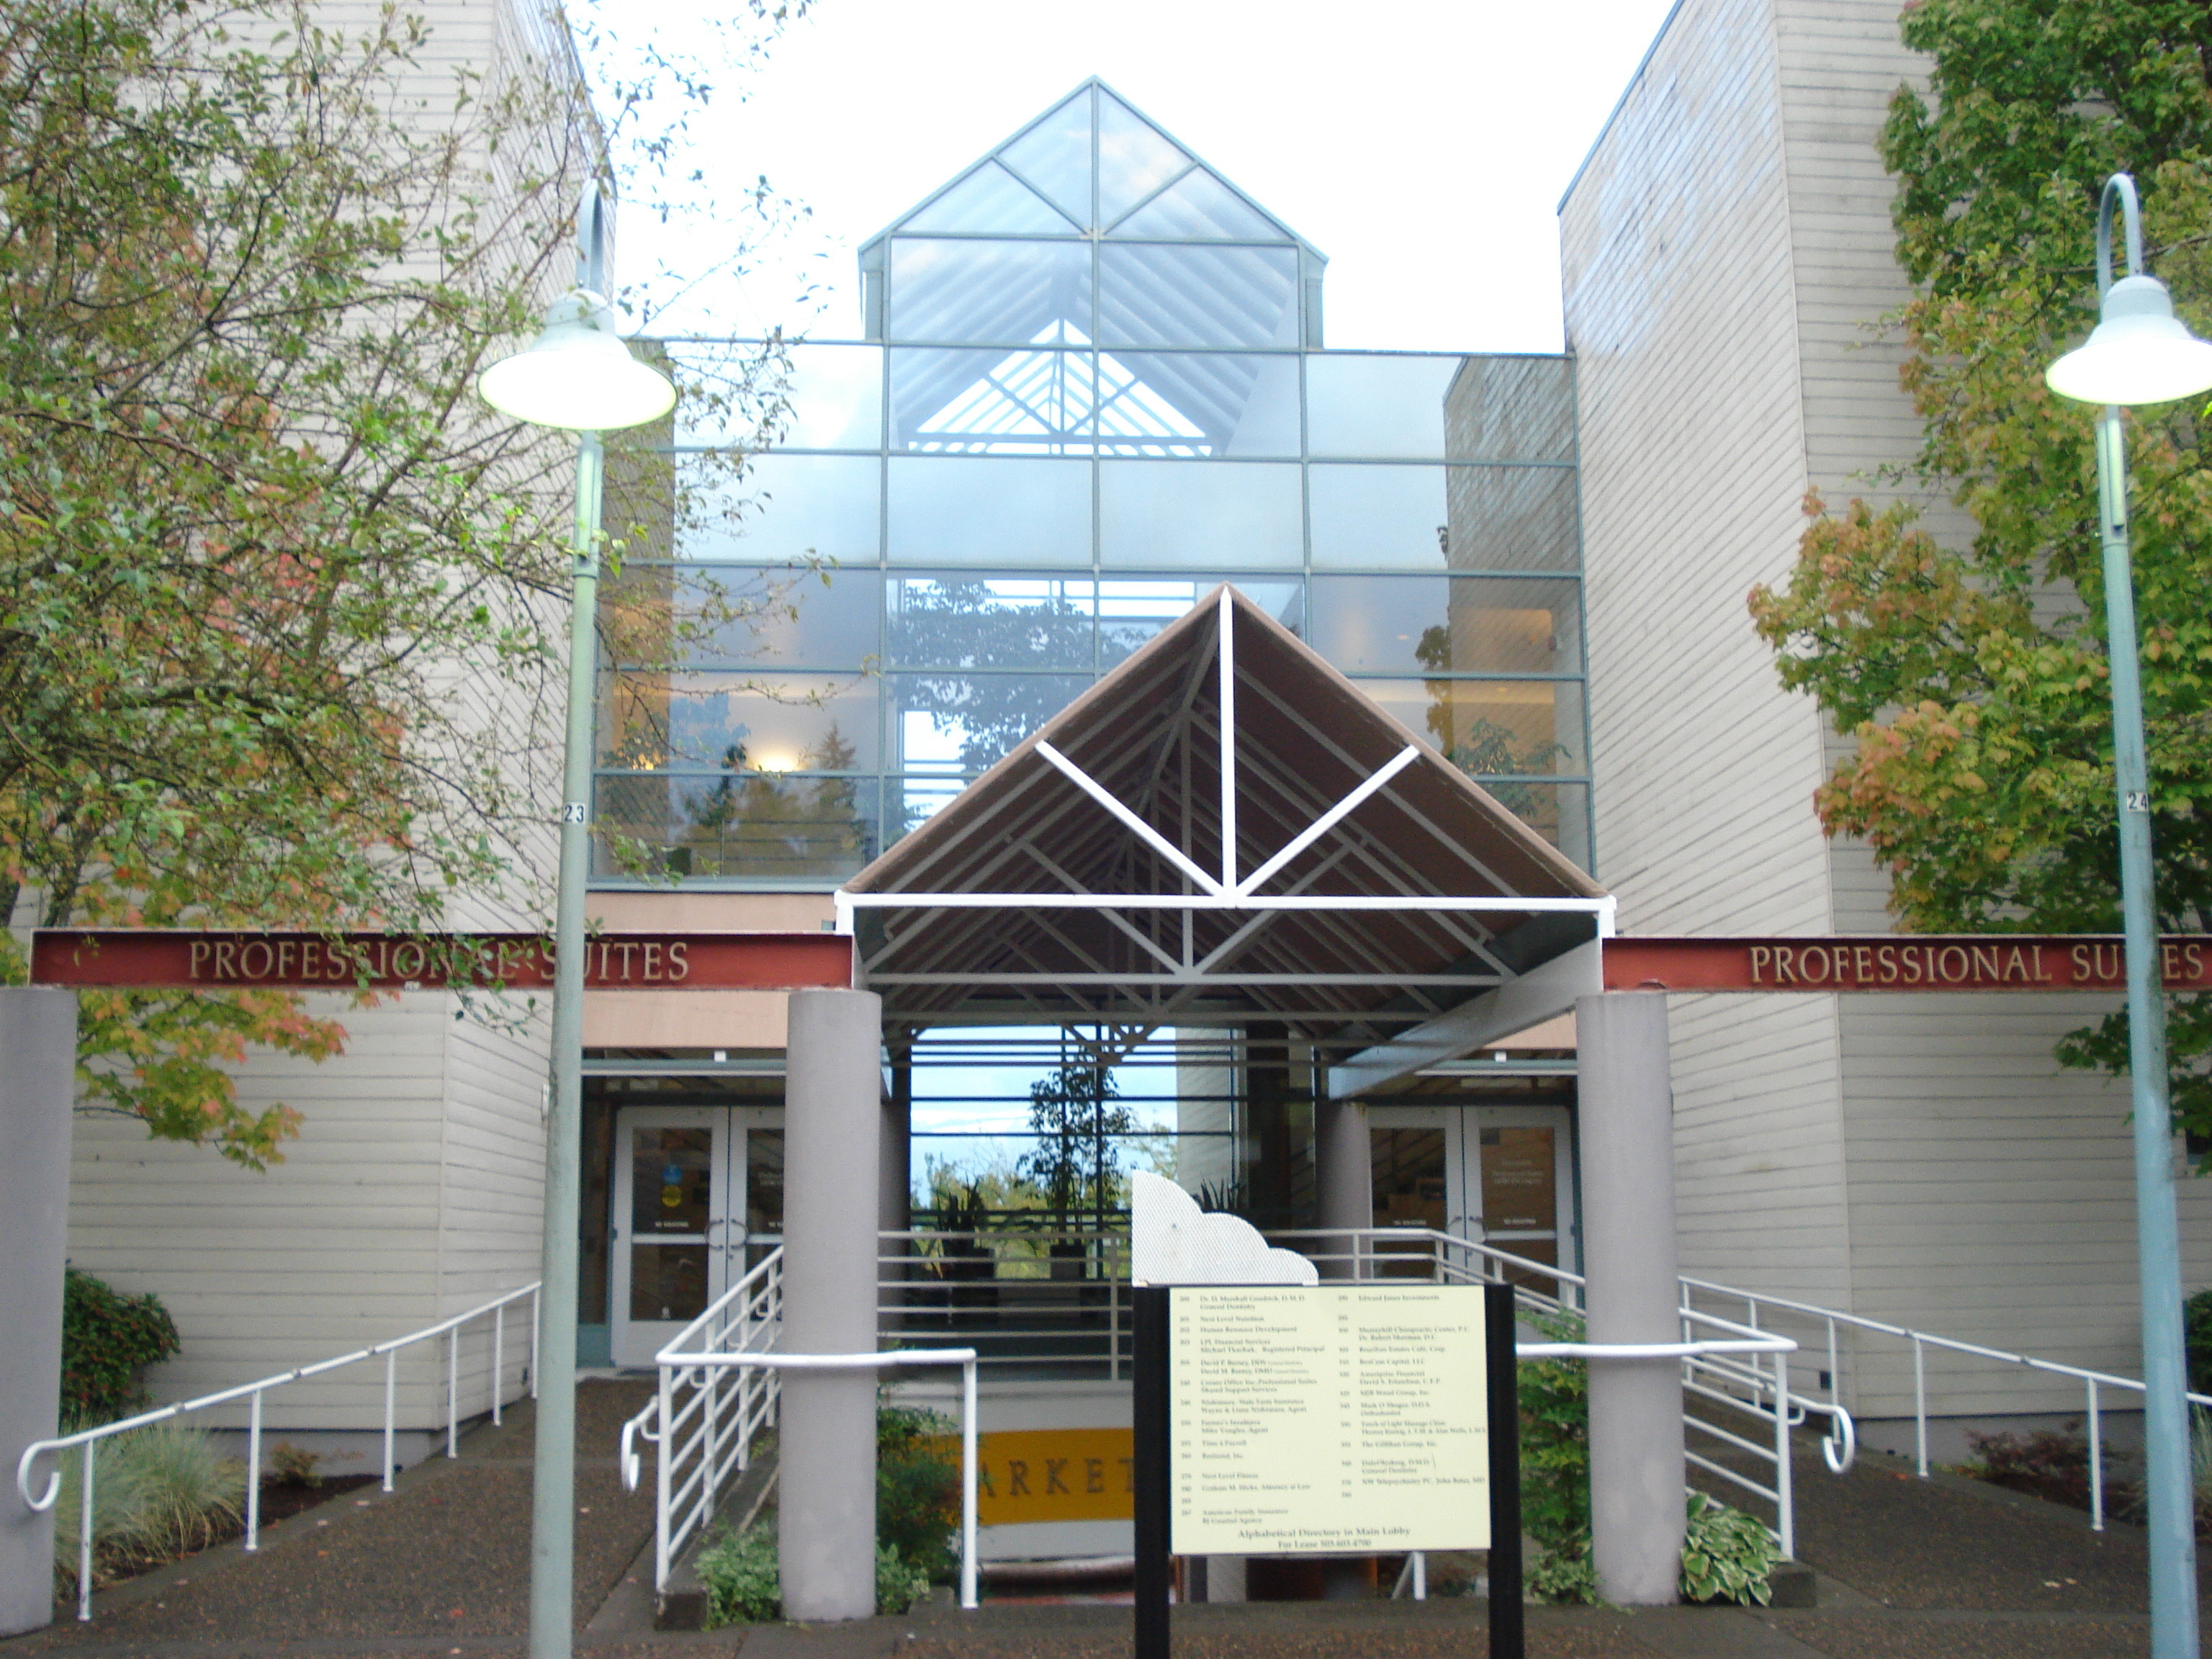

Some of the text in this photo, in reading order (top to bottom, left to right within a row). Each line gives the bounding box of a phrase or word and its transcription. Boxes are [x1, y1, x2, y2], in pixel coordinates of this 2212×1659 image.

[564, 804, 584, 822] 23
[2128, 792, 2147, 809] 24
[189, 940, 689, 981] PROFESSIONAL SITES
[1750, 943, 2204, 983] PROFESSIONAL SUES
[977, 1457, 1134, 1498] ARKET
[1238, 1530, 1295, 1539] Alphabetical
[1299, 1529, 1340, 1537] Directory
[1383, 1527, 1411, 1537] Lobby
